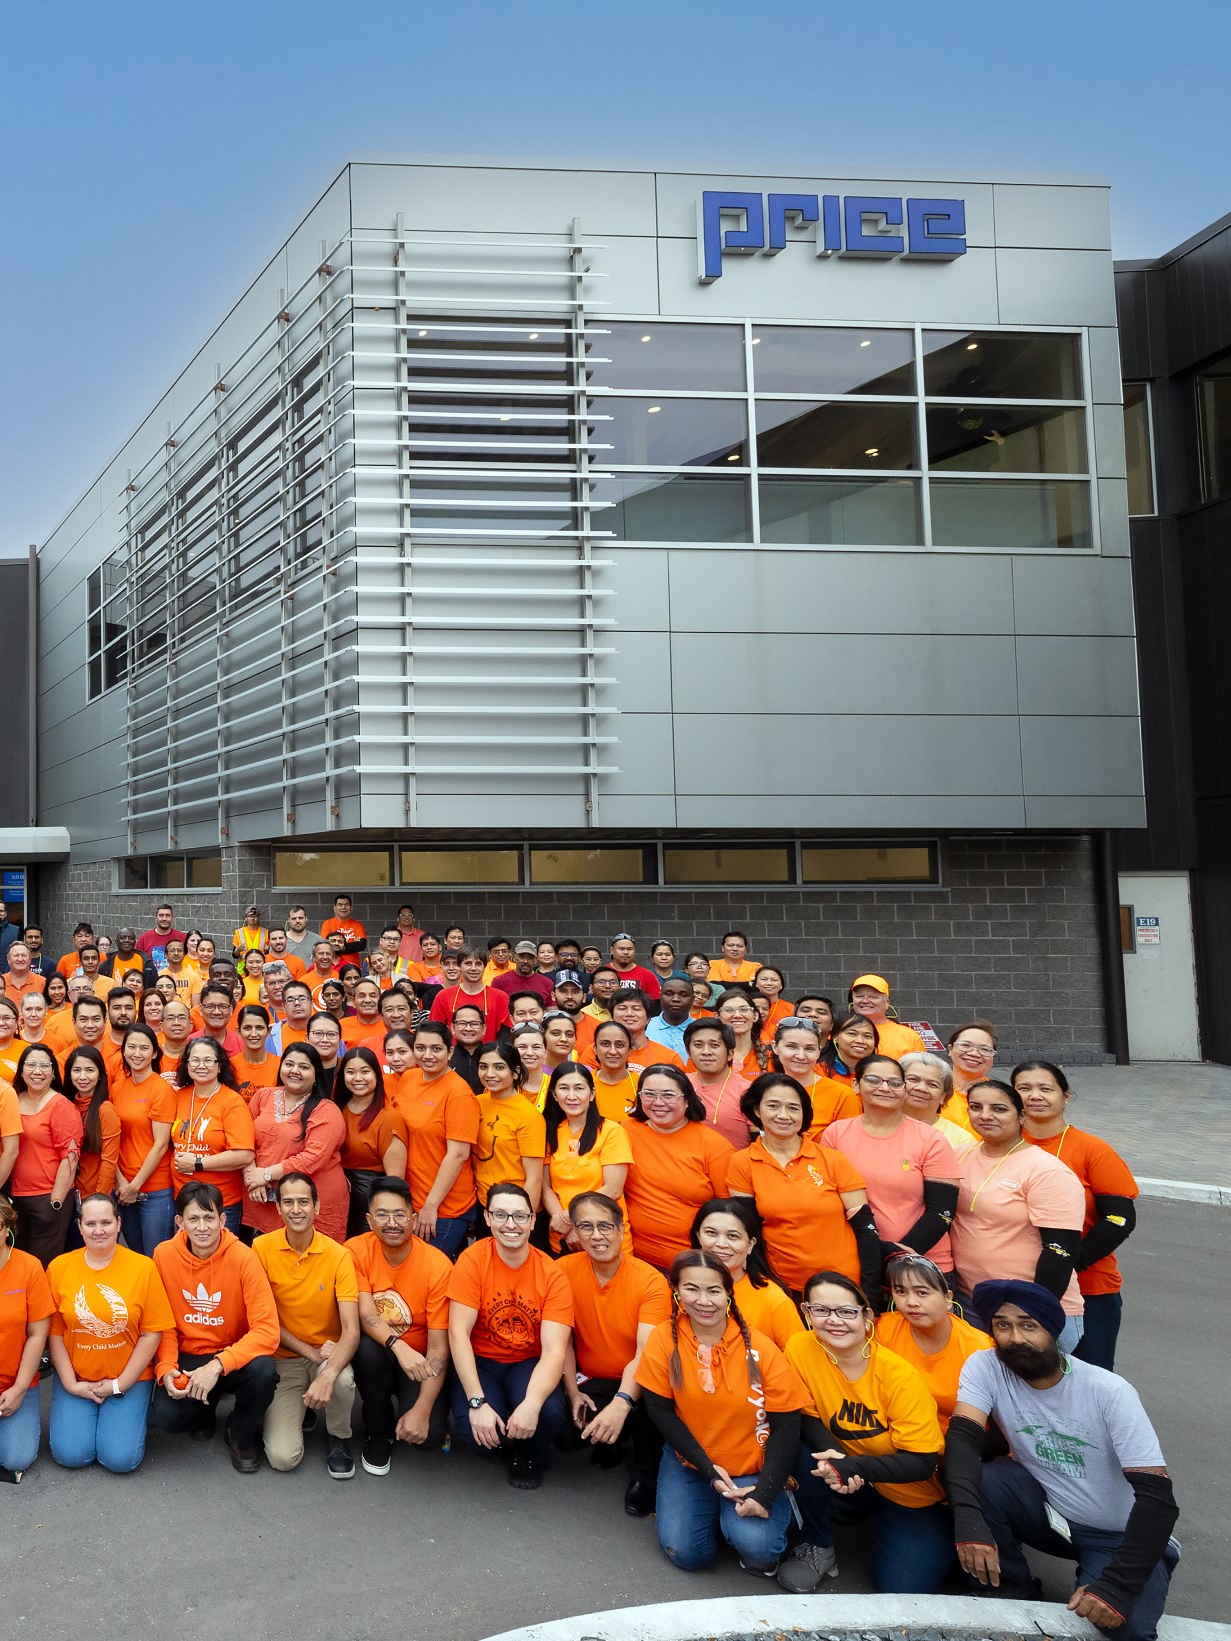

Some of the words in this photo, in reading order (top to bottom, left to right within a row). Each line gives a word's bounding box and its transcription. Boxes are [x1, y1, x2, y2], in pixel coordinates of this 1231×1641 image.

[699, 190, 967, 281] price
[1140, 918, 1156, 926] E19
[186, 1143, 210, 1153] Child
[488, 1300, 504, 1315] EVERY
[184, 1312, 224, 1326] adidas
[1035, 1444, 1086, 1466] GREEN
[1039, 1457, 1087, 1479] TEAM
